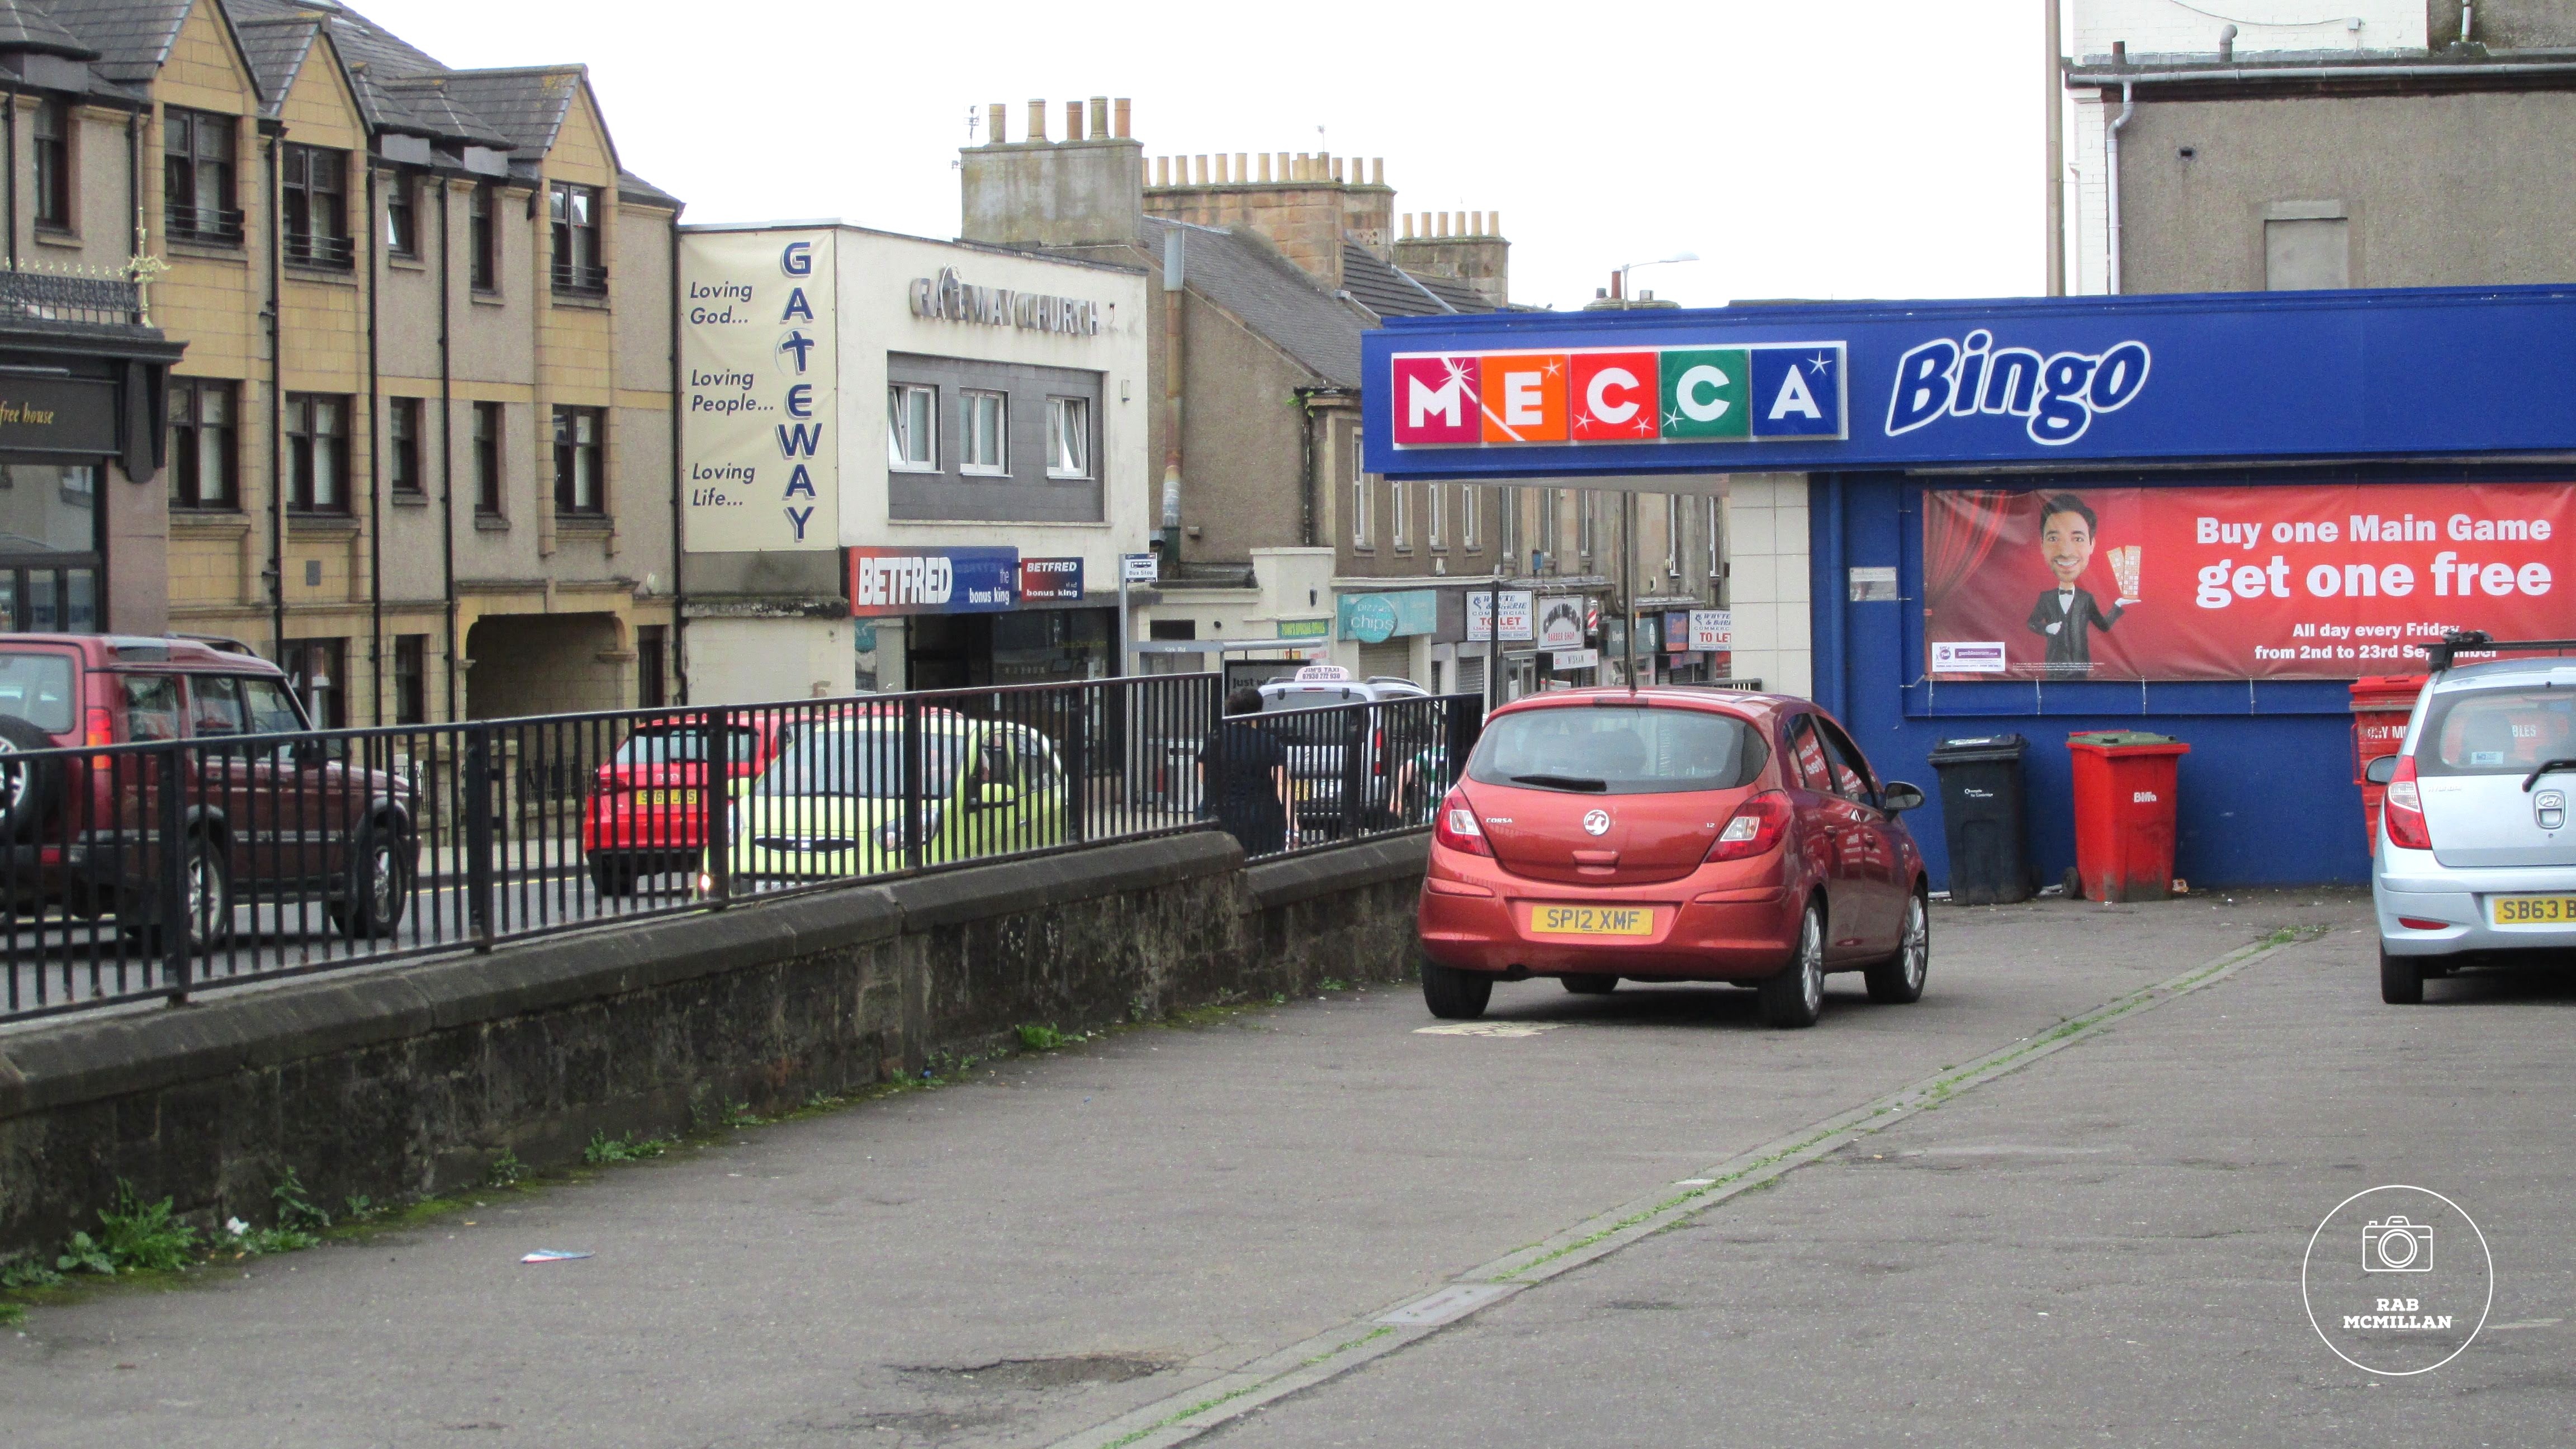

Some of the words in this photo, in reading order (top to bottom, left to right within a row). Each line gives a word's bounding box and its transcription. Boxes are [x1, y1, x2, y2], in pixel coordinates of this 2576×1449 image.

[690, 281, 753, 302] Loving
[690, 306, 749, 325] God...
[692, 369, 754, 390] Loving
[1885, 329, 2151, 446] Bingo
[775, 242, 823, 543] GATEWAY
[1409, 364, 1822, 428] MECCA
[23, 402, 54, 424] house
[692, 394, 774, 415] People...
[693, 463, 755, 484] Loving
[693, 490, 743, 506] Life...
[2196, 517, 2262, 549] Buy
[2272, 520, 2338, 543] one
[2350, 514, 2436, 542] Main
[2447, 514, 2551, 541] Game
[1000, 569, 1009, 584] the
[1027, 562, 1077, 572] BETFRED
[859, 557, 953, 605] BETFRED
[2195, 556, 2290, 609] get
[2306, 562, 2414, 597] one
[2430, 551, 2552, 596] free
[969, 588, 991, 603] bonus
[995, 587, 1010, 605] king
[1058, 589, 1078, 598] king
[1351, 615, 1394, 632] chips
[1500, 617, 1521, 626] LET
[2293, 622, 2315, 637] All
[2319, 623, 2350, 640] day
[2354, 625, 2402, 640] every
[1699, 632, 1712, 642] TO
[2255, 645, 2295, 660] from
[2300, 645, 2332, 659] 2nd
[2337, 646, 2354, 659] to
[2358, 645, 2398, 659] 23rd
[1547, 908, 1593, 929] SP12
[1599, 910, 1640, 930] XMF
[2503, 900, 2559, 920] SB63
